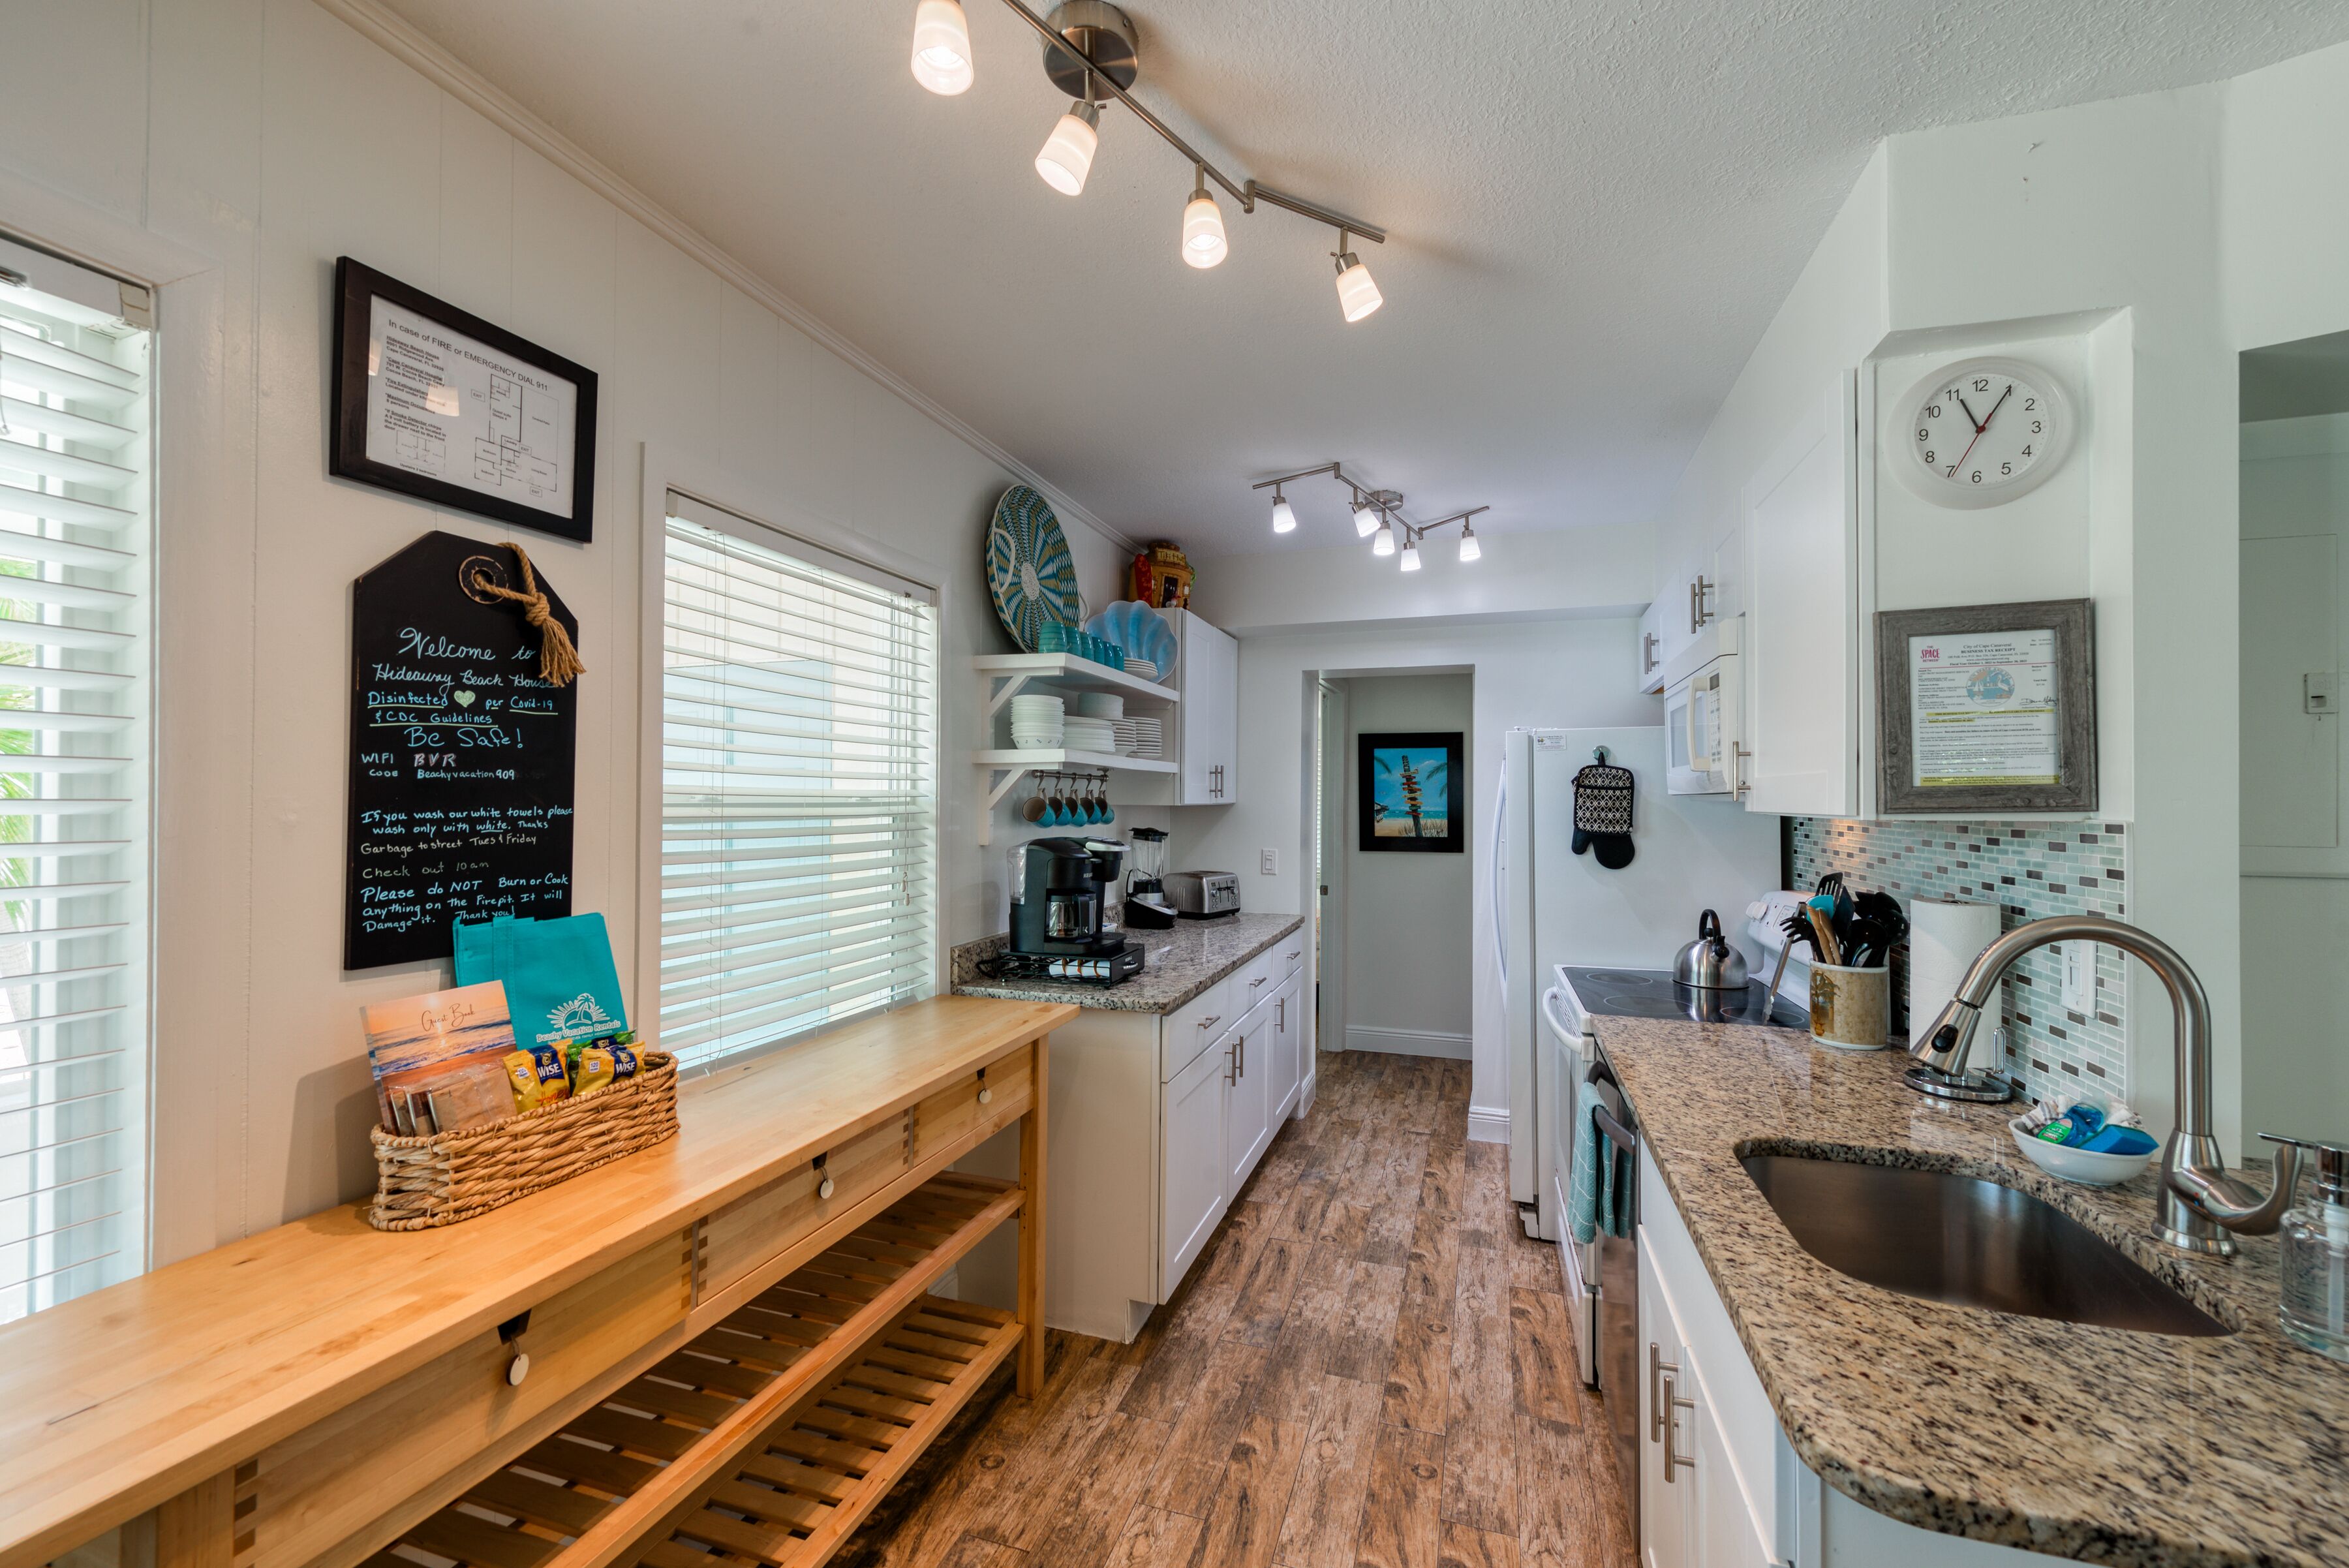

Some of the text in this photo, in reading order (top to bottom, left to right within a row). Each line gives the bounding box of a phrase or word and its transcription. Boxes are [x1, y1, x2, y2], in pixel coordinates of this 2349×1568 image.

[389, 319, 397, 329] In
[399, 325, 419, 338] case
[432, 337, 452, 352] FIRE
[464, 351, 516, 378] EMERGENCY
[517, 373, 534, 386] DIAL
[536, 381, 547, 392] 911
[1972, 378, 1989, 392] 12
[1946, 388, 1960, 401] 11
[1925, 405, 1941, 418] 10
[2025, 397, 2035, 411] 2
[2031, 420, 2042, 434] 3
[1918, 429, 1929, 441] 9
[1925, 450, 1935, 463] 8
[2021, 444, 2033, 457] 4
[1946, 465, 1956, 478] 7
[2001, 462, 2011, 475] 5
[1971, 470, 1982, 484] 6
[1158, 551, 1185, 564] Tiki Hut
[397, 627, 536, 660] Welcome to
[1920, 648, 1940, 659] SPACE
[372, 664, 555, 696] Hideaway Beach House
[368, 691, 553, 710] Disinfected per Covid-19
[386, 712, 418, 722] CDC
[430, 713, 493, 724] Guidelines
[404, 726, 445, 747] Be
[361, 752, 457, 767] WIFI BVR
[361, 810, 381, 823] If
[382, 813, 408, 826] you
[413, 810, 444, 819] wash
[470, 807, 501, 818] white
[506, 805, 544, 817] towels
[547, 805, 573, 820] please
[373, 820, 549, 838] wash only with white. Thanks
[361, 842, 414, 858] Garbage
[418, 841, 429, 850] to
[430, 839, 463, 849] street
[469, 836, 496, 846] Tues
[506, 833, 537, 845] Friday
[363, 865, 410, 879] Check
[422, 861, 444, 874] out
[456, 862, 467, 872] 10
[360, 885, 416, 903] Please
[427, 882, 444, 895] do
[450, 880, 483, 893] NOT
[498, 876, 527, 888] Burn
[544, 872, 569, 885] Cook
[362, 902, 421, 921] anything
[447, 898, 468, 907] the
[520, 893, 536, 902] It
[544, 889, 562, 900] will
[362, 920, 412, 932] Damage
[421, 914, 436, 924] it.
[455, 910, 488, 920] Thank
[421, 1002, 475, 1032] Guest Book
[536, 1030, 562, 1043] Beachy
[562, 1026, 593, 1038] Vacation
[593, 1020, 621, 1032] Rentals
[537, 1063, 561, 1078] WISE
[615, 1062, 636, 1074] WISE
